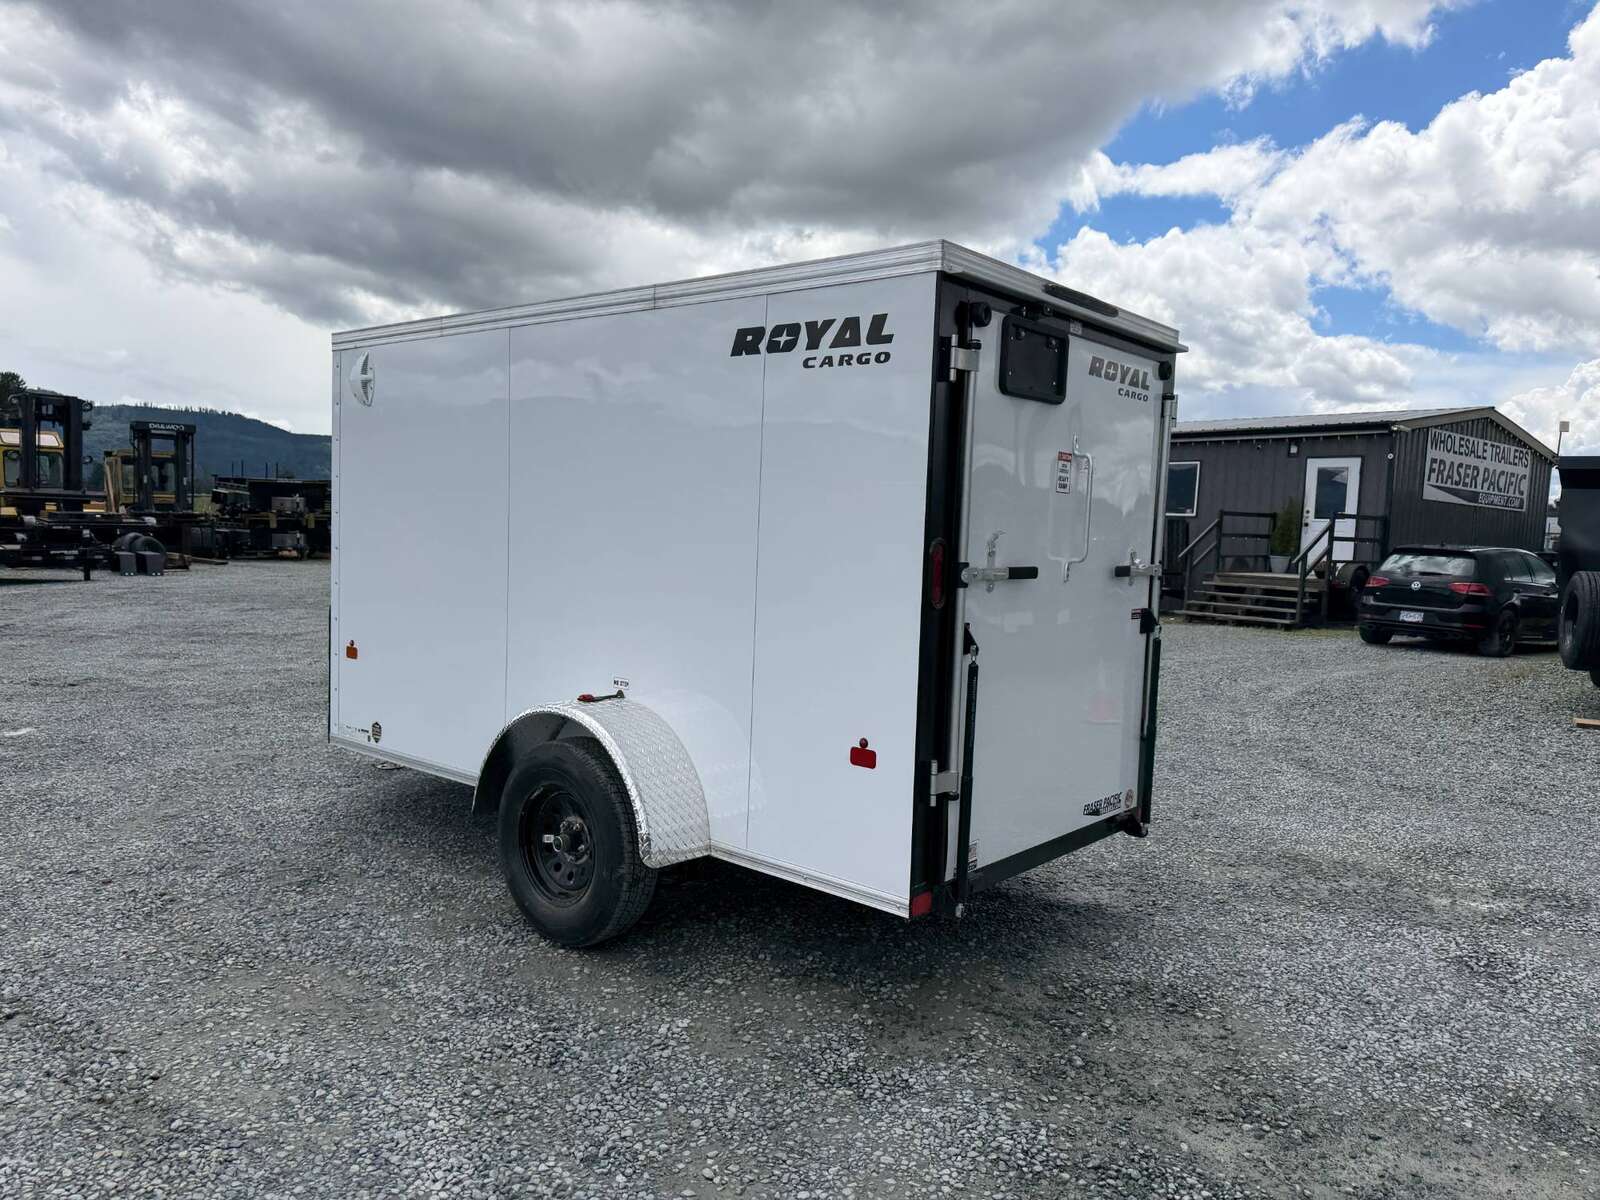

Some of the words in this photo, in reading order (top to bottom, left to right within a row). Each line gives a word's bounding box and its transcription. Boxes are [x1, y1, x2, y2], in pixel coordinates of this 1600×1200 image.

[730, 313, 894, 357] ROYAL
[803, 352, 891, 369] CARGO
[1089, 356, 1150, 391] ROYAL
[1118, 388, 1149, 402] CARGO
[1430, 430, 1487, 460] WHOLESALE
[1490, 444, 1529, 469] TRAILERS
[1427, 457, 1480, 489] FRASER
[1481, 467, 1527, 496] PACIFIC
